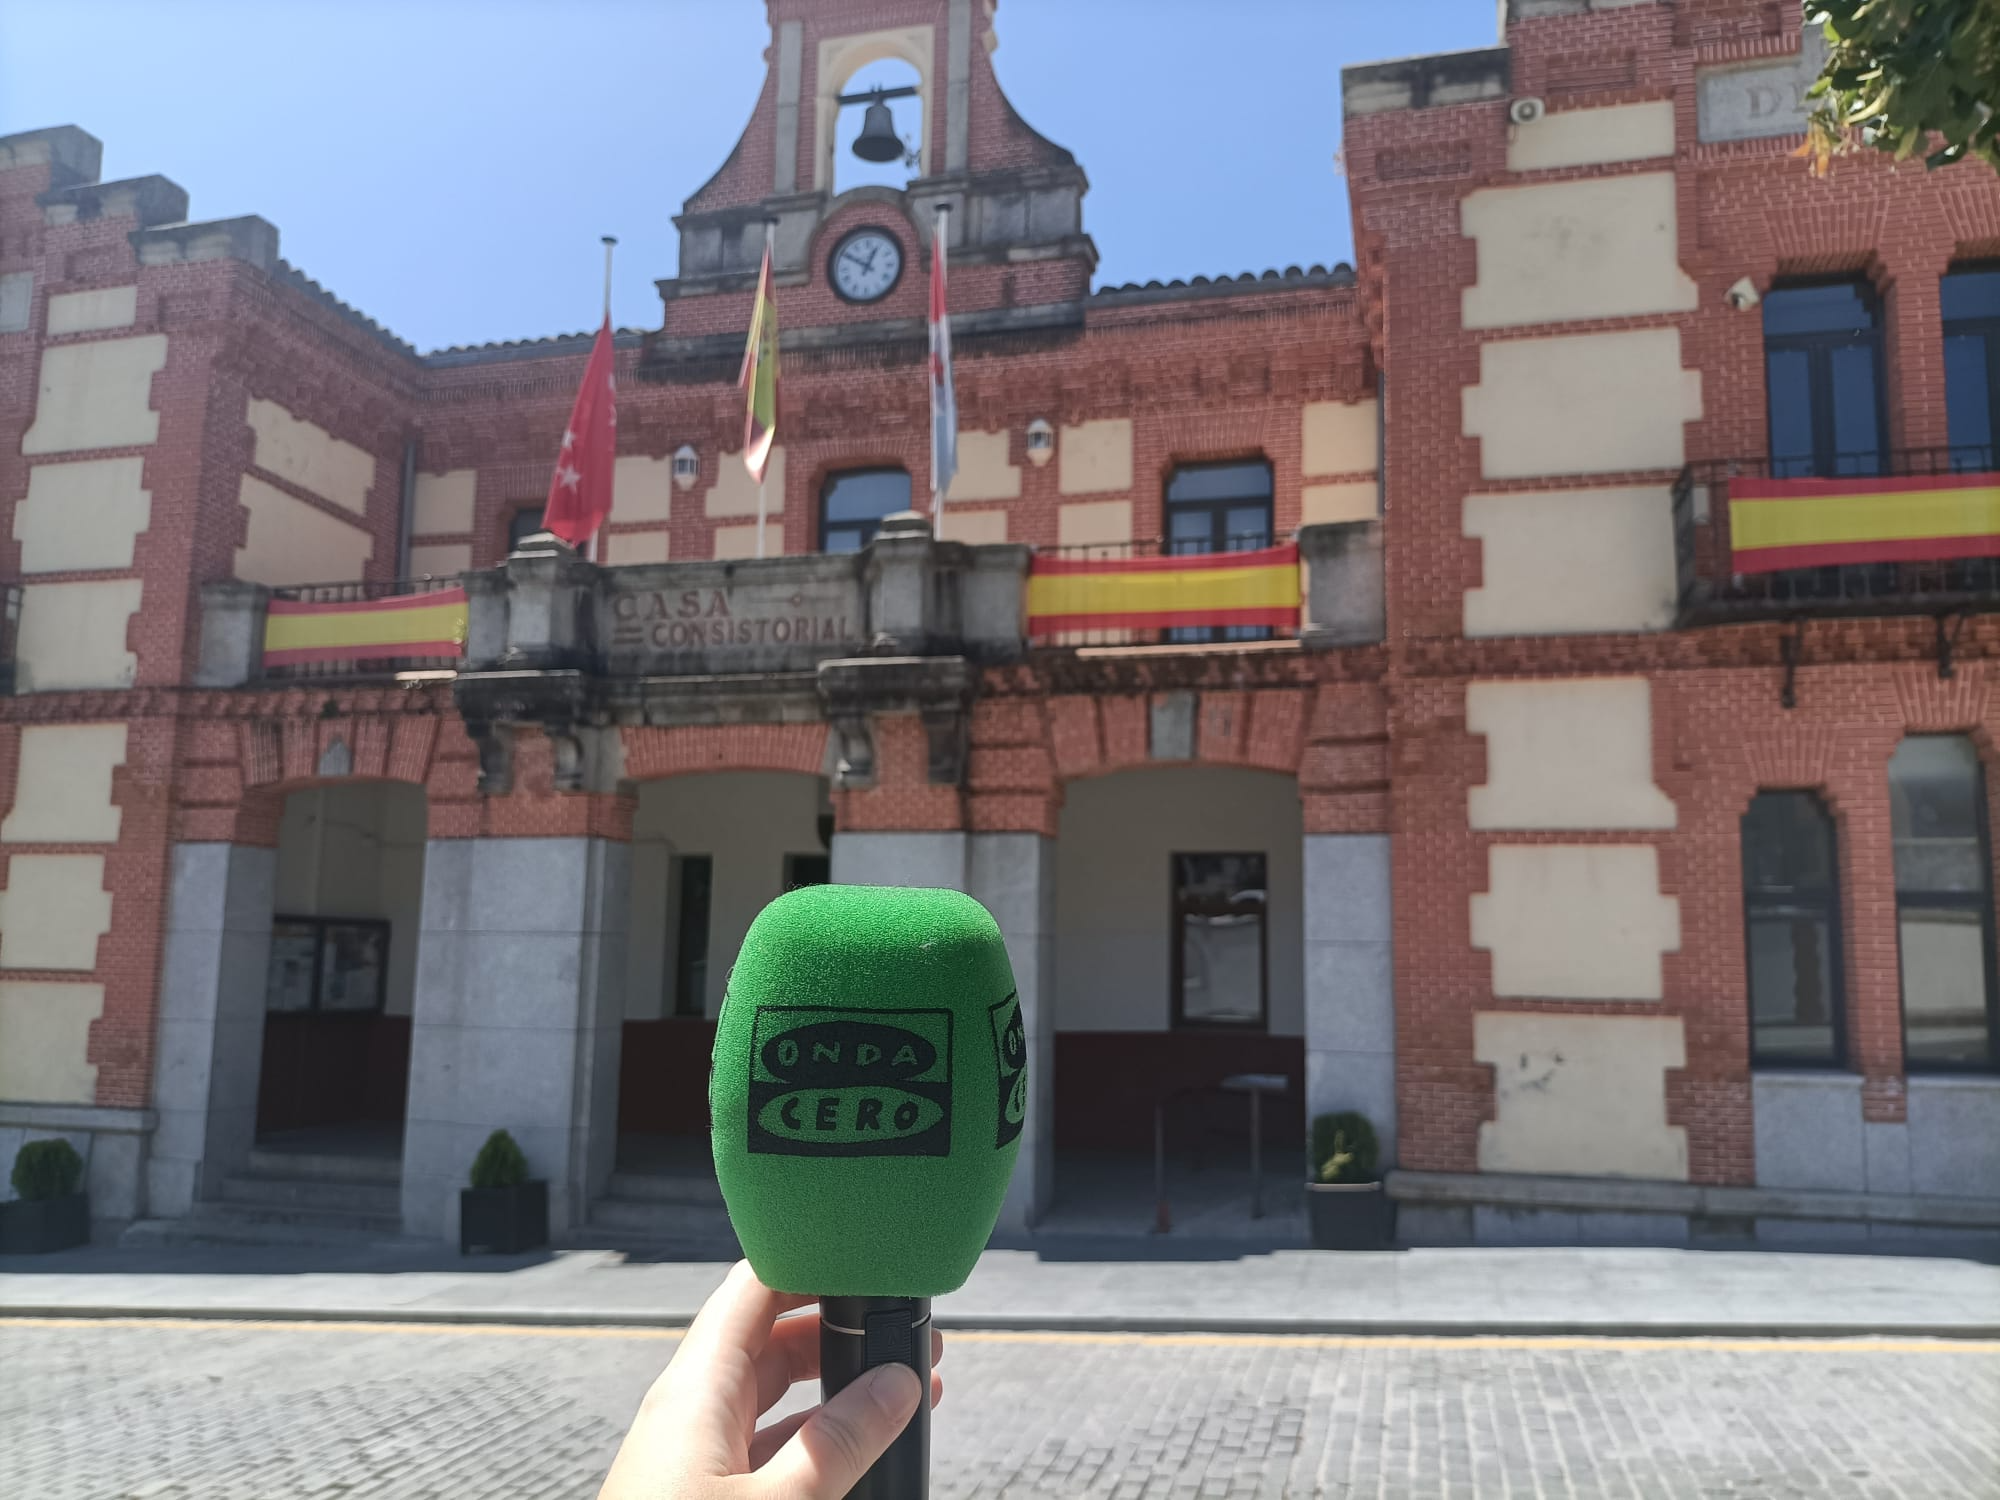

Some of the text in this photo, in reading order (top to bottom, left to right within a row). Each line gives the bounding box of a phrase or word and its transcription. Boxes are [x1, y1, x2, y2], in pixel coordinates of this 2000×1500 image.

[613, 590, 731, 621] CASA
[651, 616, 855, 648] CONSISTORIAL
[777, 1039, 918, 1067] ONDA
[780, 1096, 919, 1131] CERO
